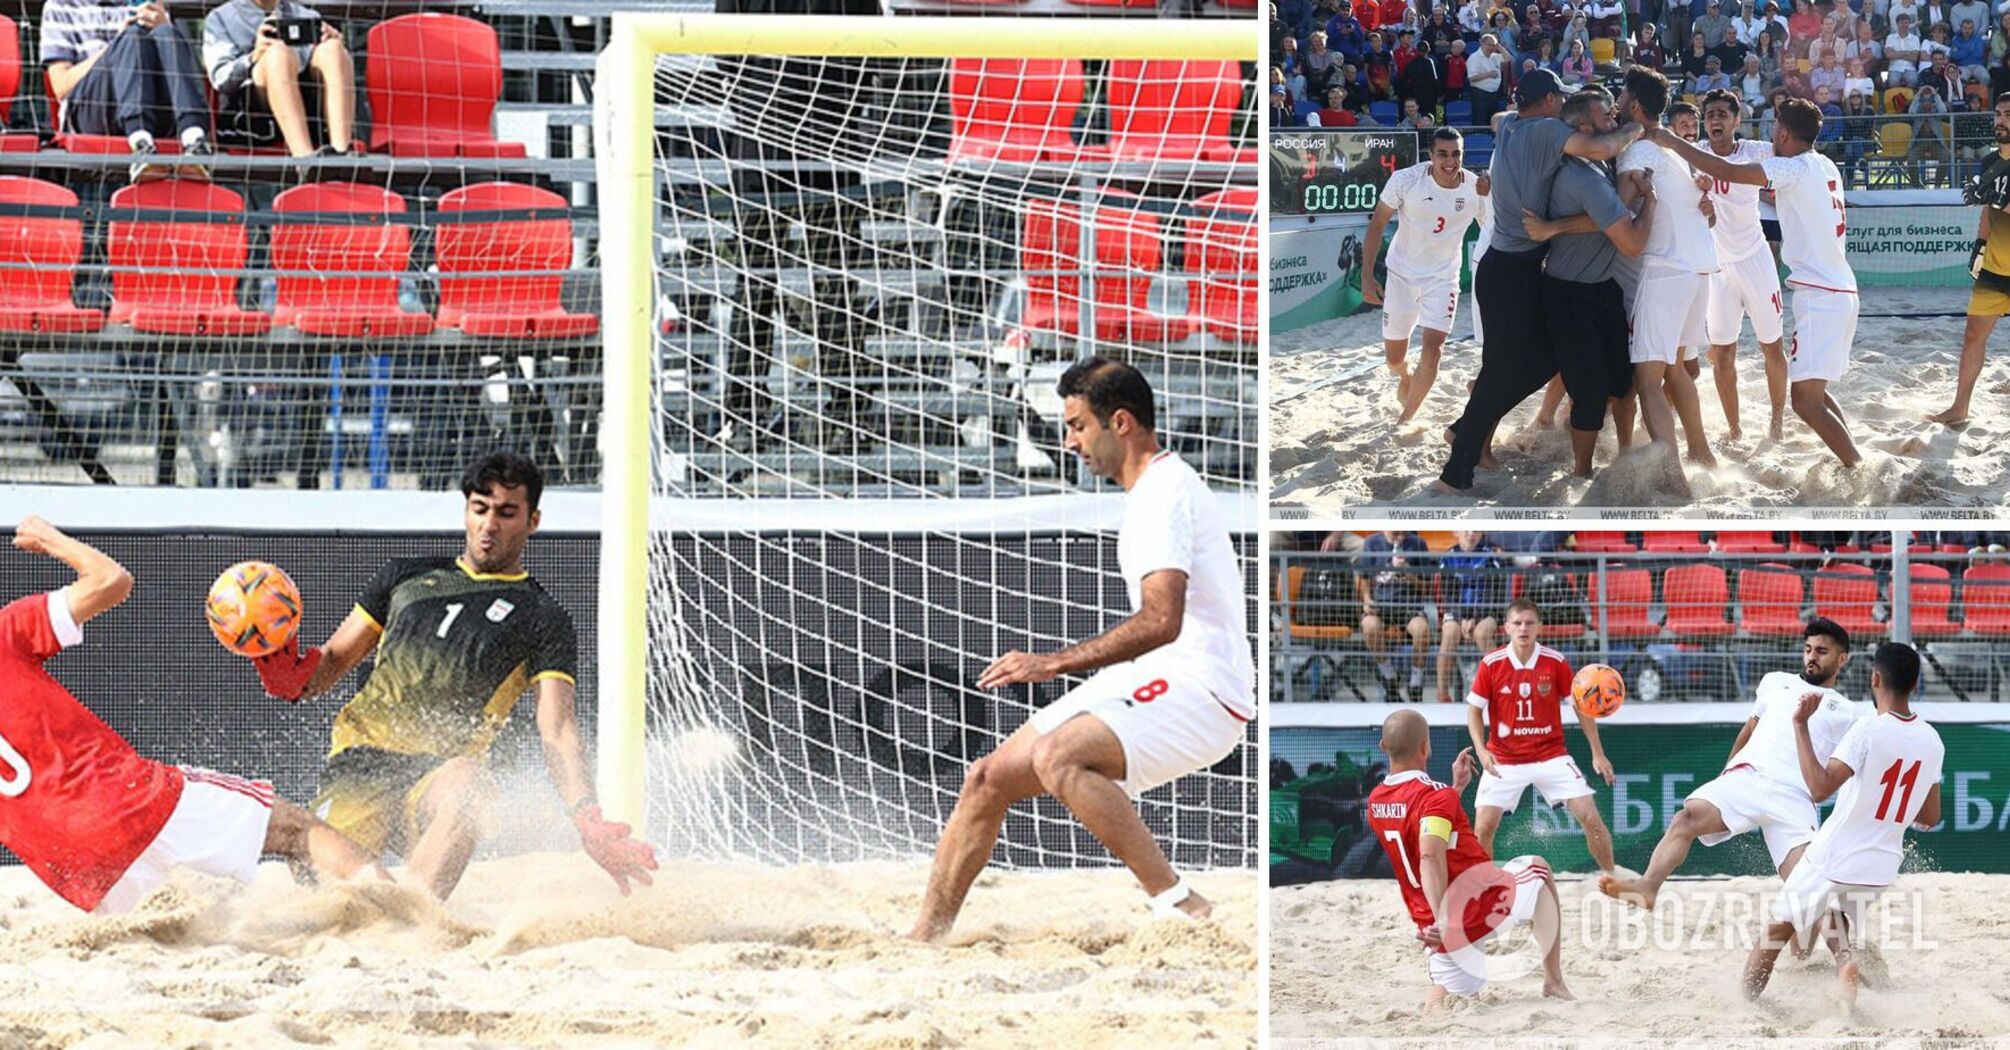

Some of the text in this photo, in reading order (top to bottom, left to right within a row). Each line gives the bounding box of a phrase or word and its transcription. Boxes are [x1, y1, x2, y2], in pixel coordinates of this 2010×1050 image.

[1275, 138, 1394, 149] РОССИЯ ИРАН
[1380, 153, 1396, 176] 4
[1993, 175, 2008, 195] 12
[1304, 184, 1377, 210] 00.00
[1433, 216, 1446, 234] 3
[1877, 227, 1902, 237] для
[1907, 224, 1962, 236] бизнеса
[1845, 241, 1891, 254] ЯЩАЯ
[436, 603, 464, 638] 1
[1133, 678, 1168, 702] 8
[1516, 699, 1534, 720] 11
[1875, 758, 1922, 824] 11
[1371, 803, 1406, 818] SHKARIN
[1384, 830, 1420, 888] 7
